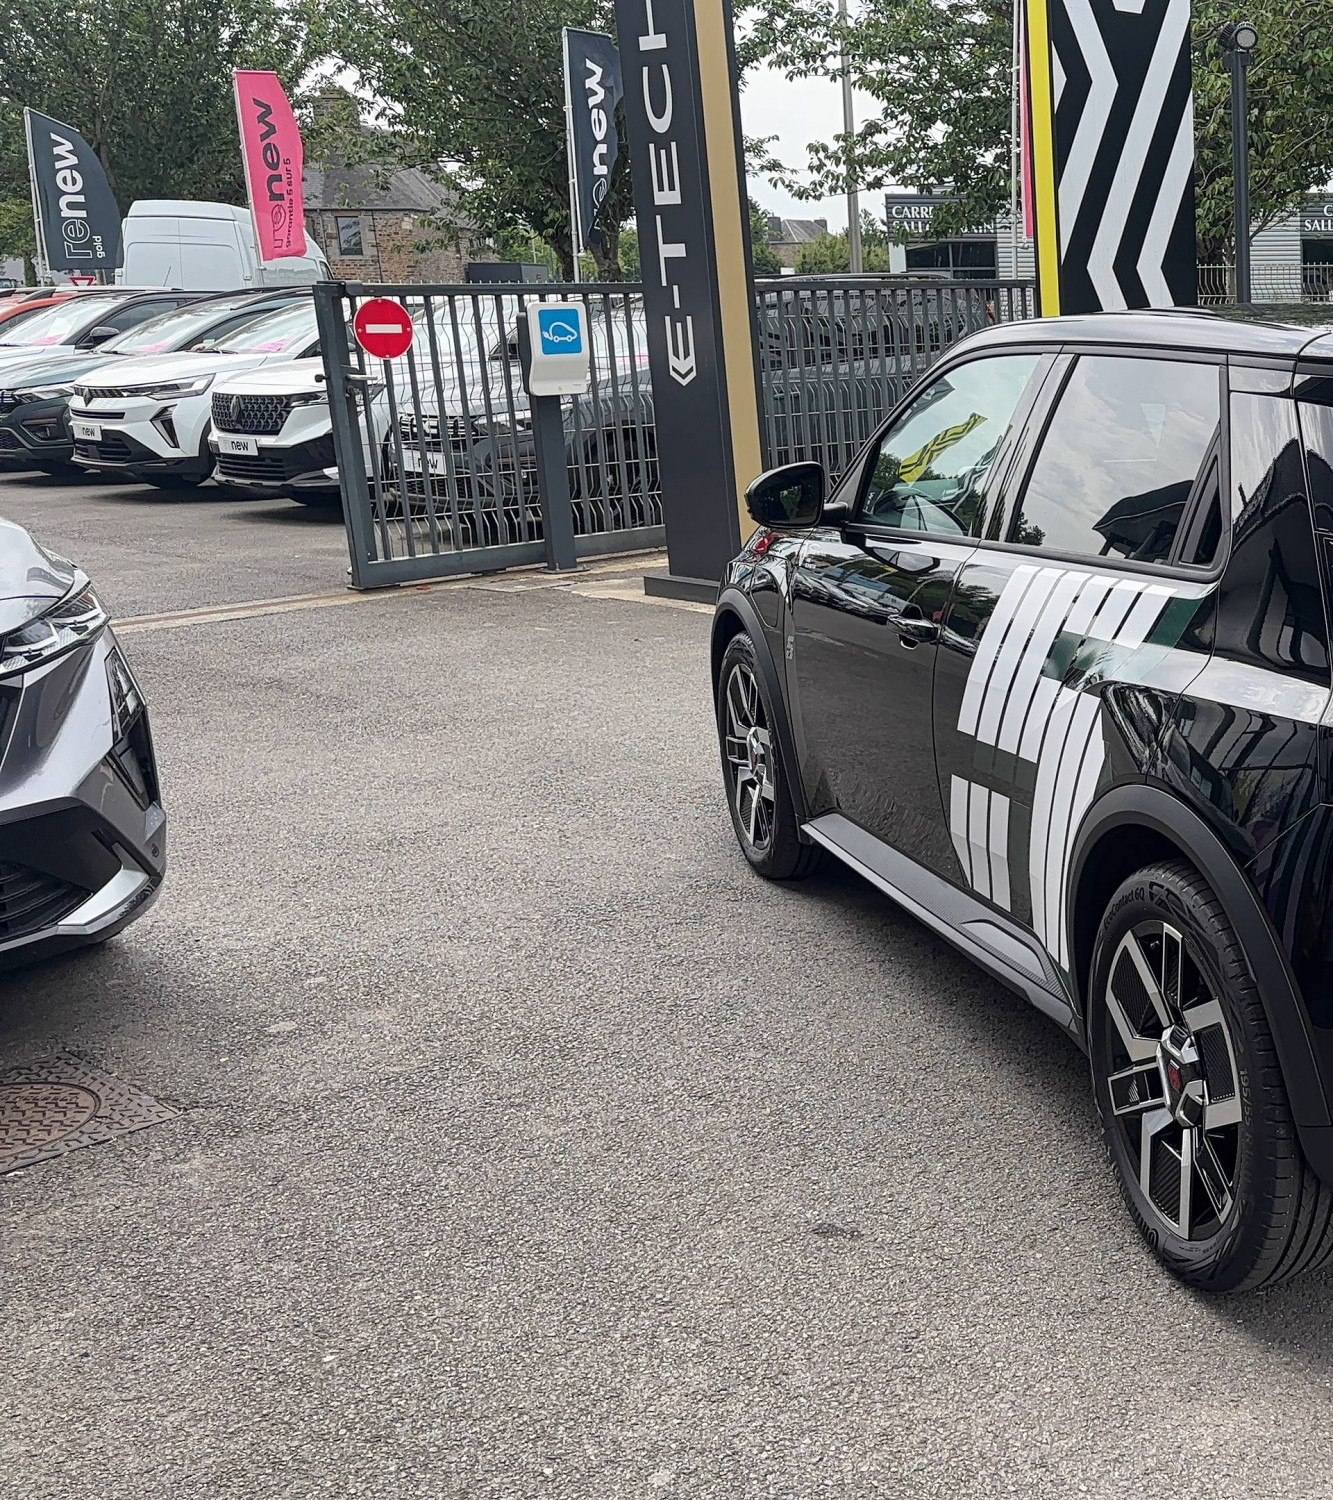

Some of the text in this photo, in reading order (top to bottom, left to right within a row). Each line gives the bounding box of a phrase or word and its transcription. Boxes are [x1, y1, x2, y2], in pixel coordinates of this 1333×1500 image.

[252, 97, 286, 249] renew
[283, 157, 292, 166] 5
[285, 168, 293, 188] sur
[50, 132, 93, 259] renew
[92, 235, 106, 259] gold
[285, 200, 294, 248] garantie
[1239, 1068, 1254, 1127] 195/55
